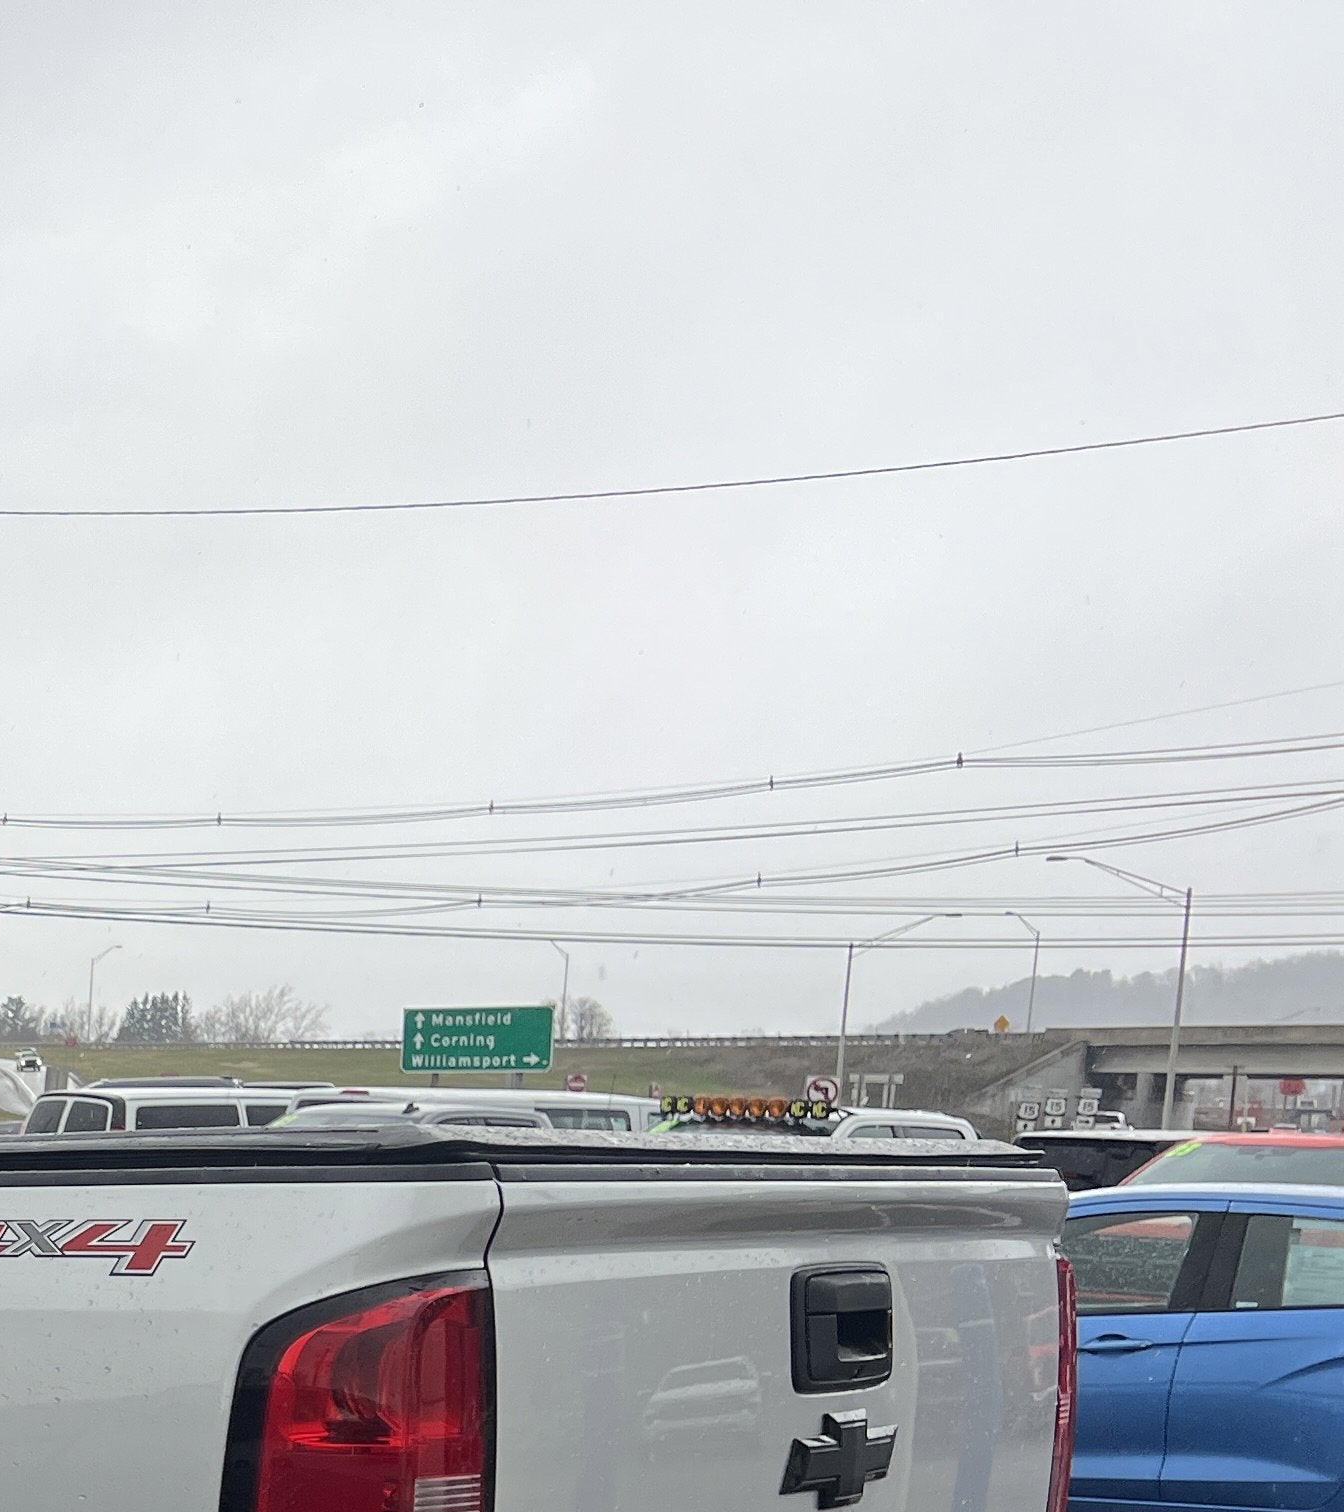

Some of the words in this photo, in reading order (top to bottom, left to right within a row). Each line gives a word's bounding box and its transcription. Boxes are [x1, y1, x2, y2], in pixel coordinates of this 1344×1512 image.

[431, 1012, 512, 1026] Mansfield
[430, 1033, 496, 1050] Corning
[411, 1054, 516, 1069] Williamsport
